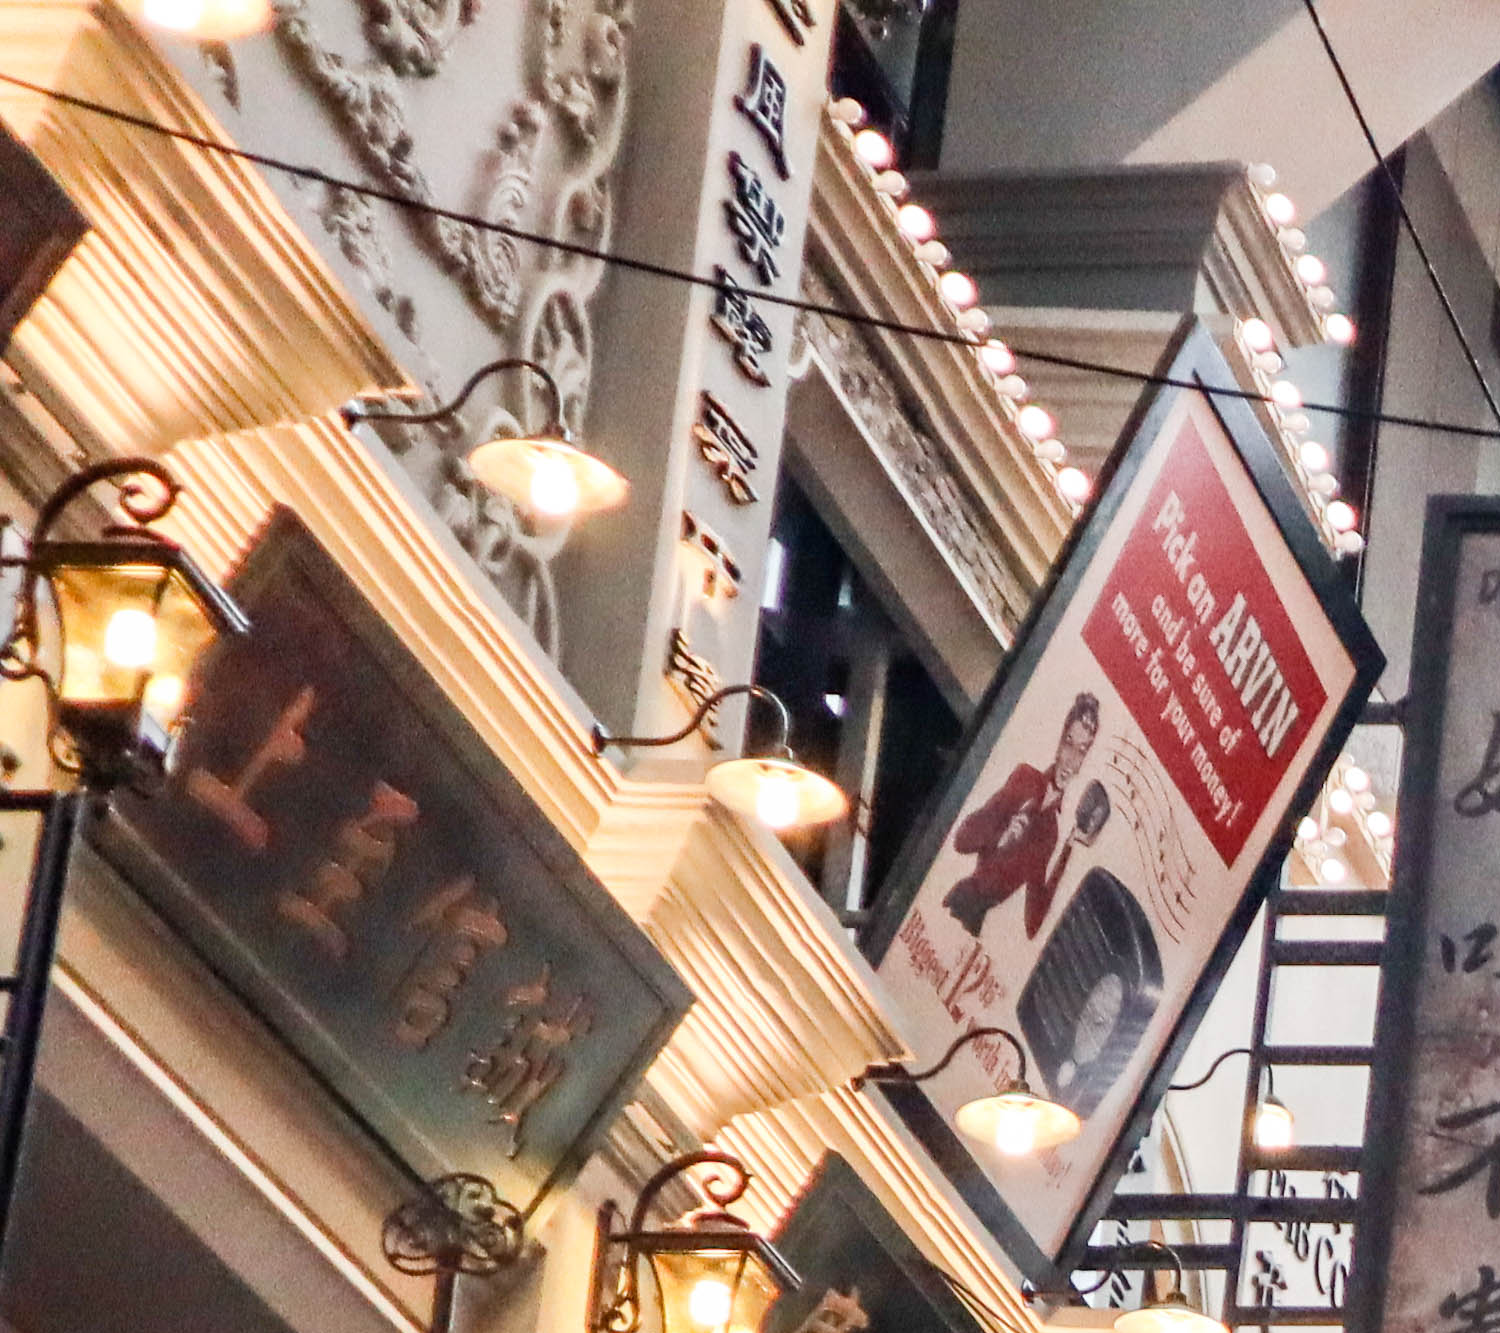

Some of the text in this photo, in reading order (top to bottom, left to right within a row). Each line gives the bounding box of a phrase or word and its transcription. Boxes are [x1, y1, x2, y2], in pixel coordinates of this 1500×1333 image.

[1109, 586, 1245, 830] more for your money!
[1147, 587, 1241, 760] and be sure of
[1150, 489, 1205, 568] Pick
[1208, 592, 1301, 761] ARVIN
